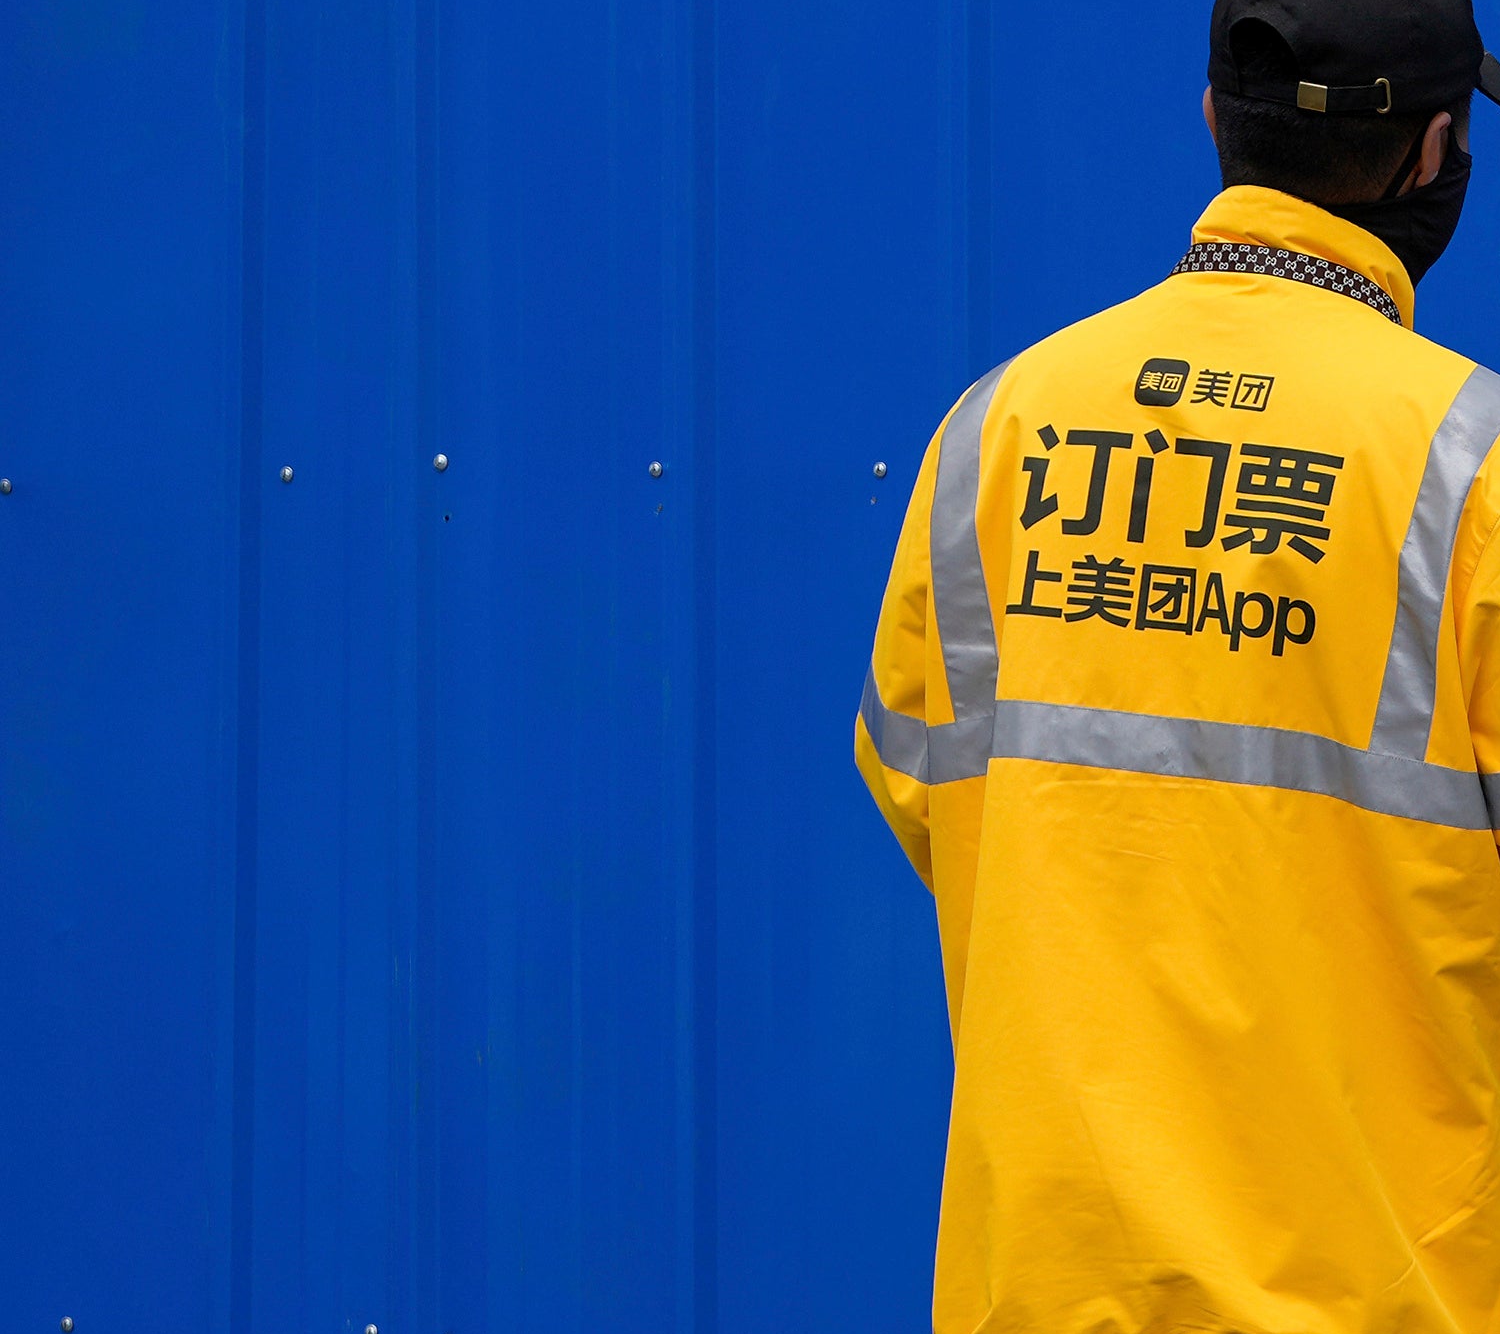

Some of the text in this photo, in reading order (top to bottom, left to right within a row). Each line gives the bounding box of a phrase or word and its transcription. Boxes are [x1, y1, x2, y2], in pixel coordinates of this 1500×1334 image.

[1139, 370, 1184, 394] 美团
[1190, 369, 1274, 412] 美团
[1020, 424, 1344, 564] 订门票
[1006, 551, 1315, 656] 上美团App
